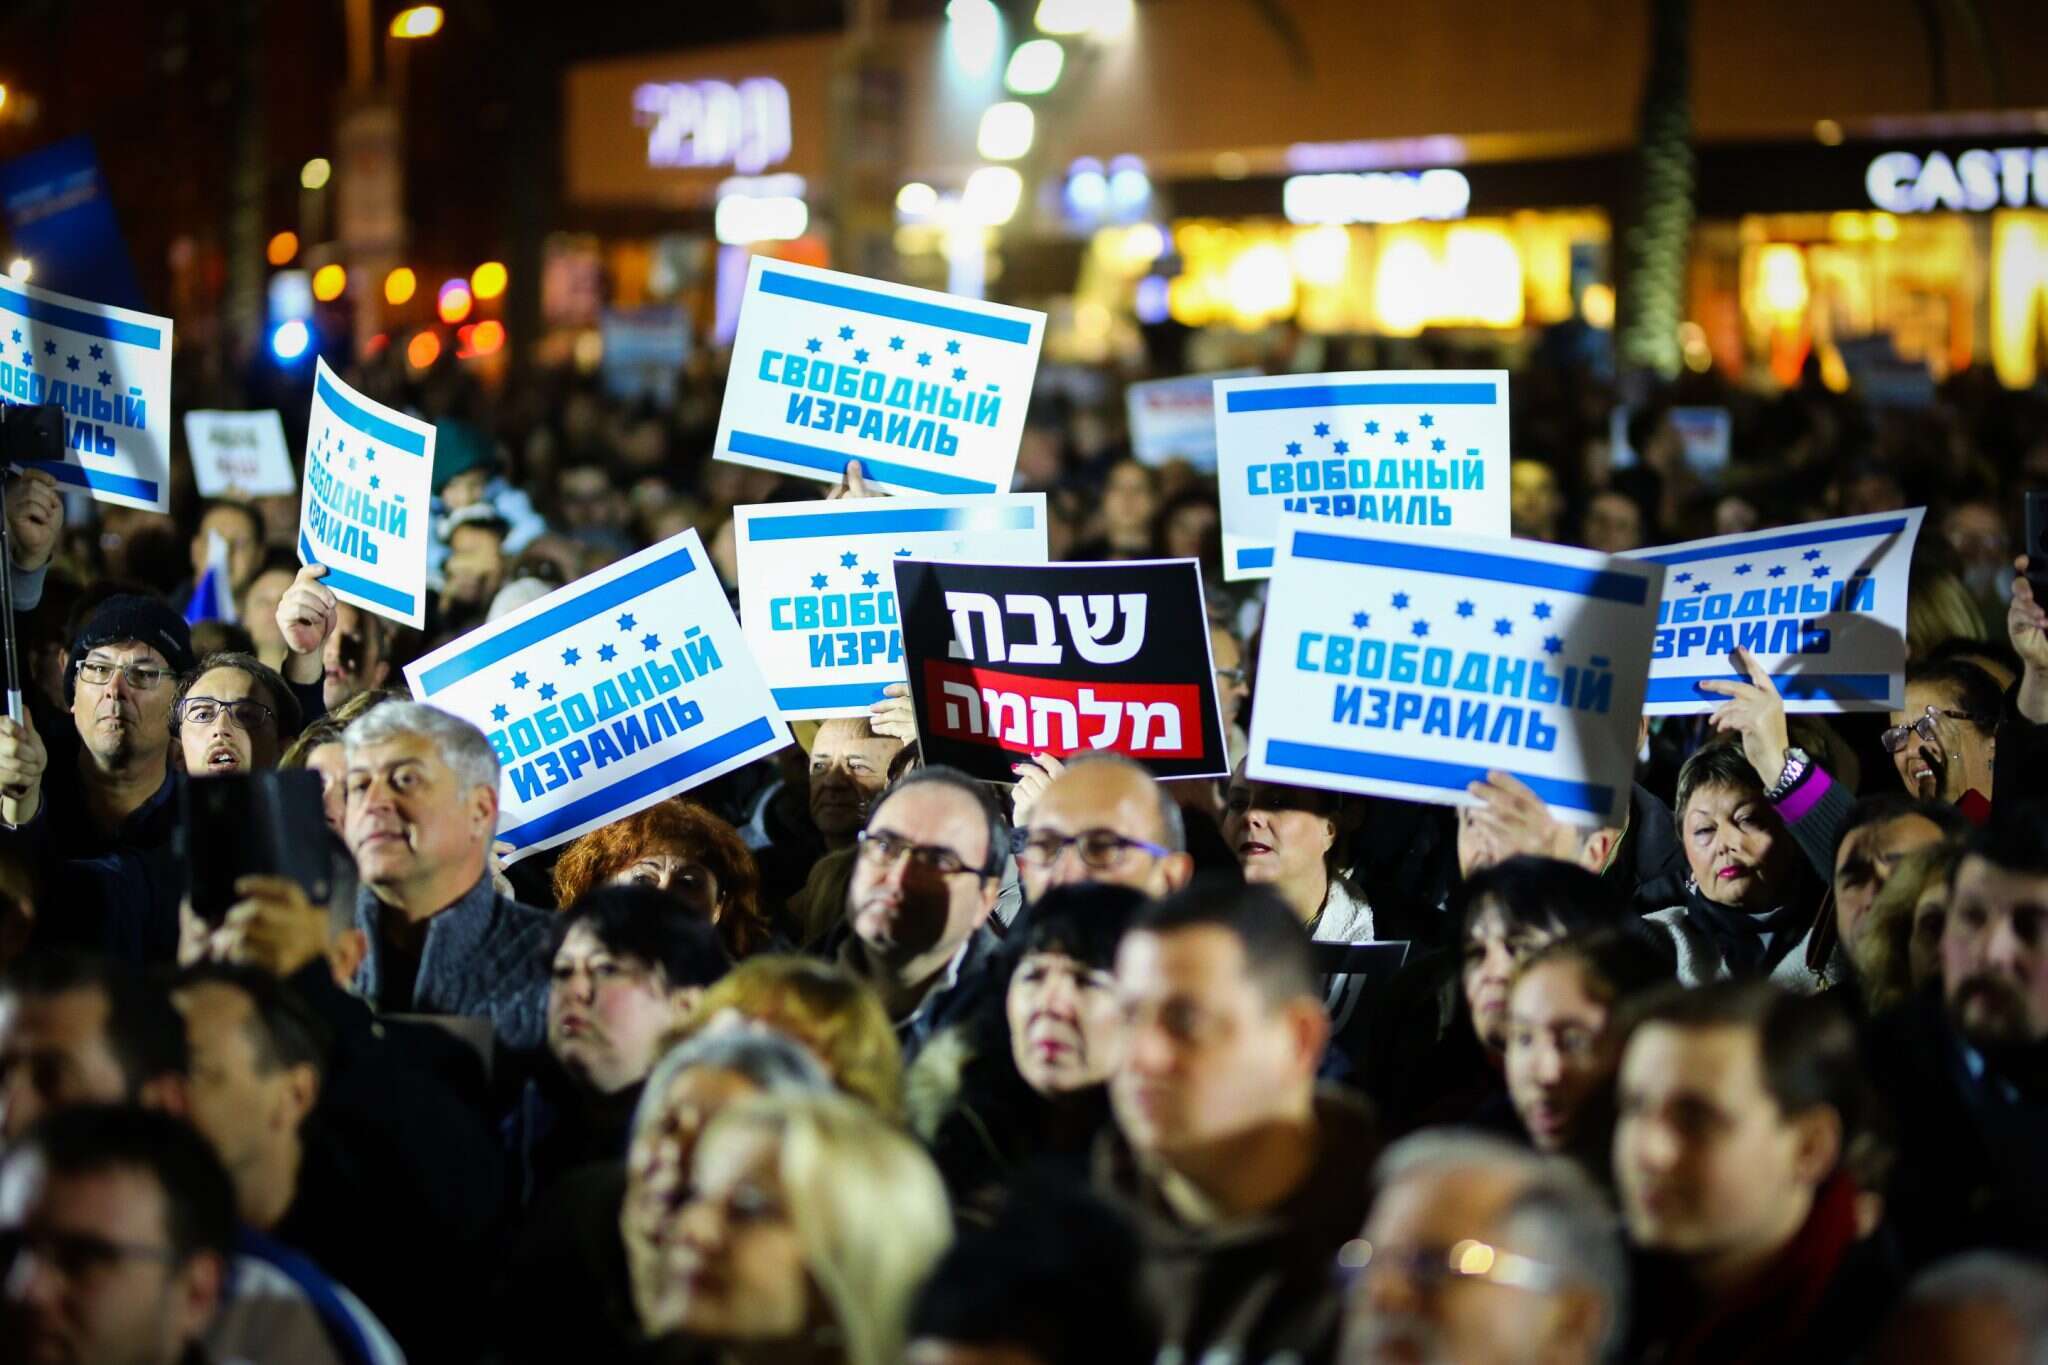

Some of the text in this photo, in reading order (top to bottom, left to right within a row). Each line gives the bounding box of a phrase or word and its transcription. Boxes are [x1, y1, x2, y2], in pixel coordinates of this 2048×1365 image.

[1865, 147, 2048, 213] CAST
[0, 361, 146, 430] ОБОДНЫЙ
[758, 349, 1002, 428] СВОБОДНЫЙ
[786, 392, 960, 457] ИЗРАИЛЬ
[1247, 448, 1485, 496] СВОБОДНЫЙ
[770, 591, 899, 631] СВОБО
[944, 591, 1148, 664] שבת
[1658, 567, 1876, 624] БОДНЫЙ
[808, 629, 905, 668] ИЗРА
[1296, 631, 1614, 715] СВОБОДНЫЙ
[1650, 618, 1831, 659] ЗРАИЛЬ
[487, 625, 724, 768] ВОБОДНЫЙ
[943, 680, 1183, 750] מלחמה
[1331, 683, 1558, 752] ИЗРАИЛЬ
[508, 695, 704, 804] ИЗРАИЛЬ
